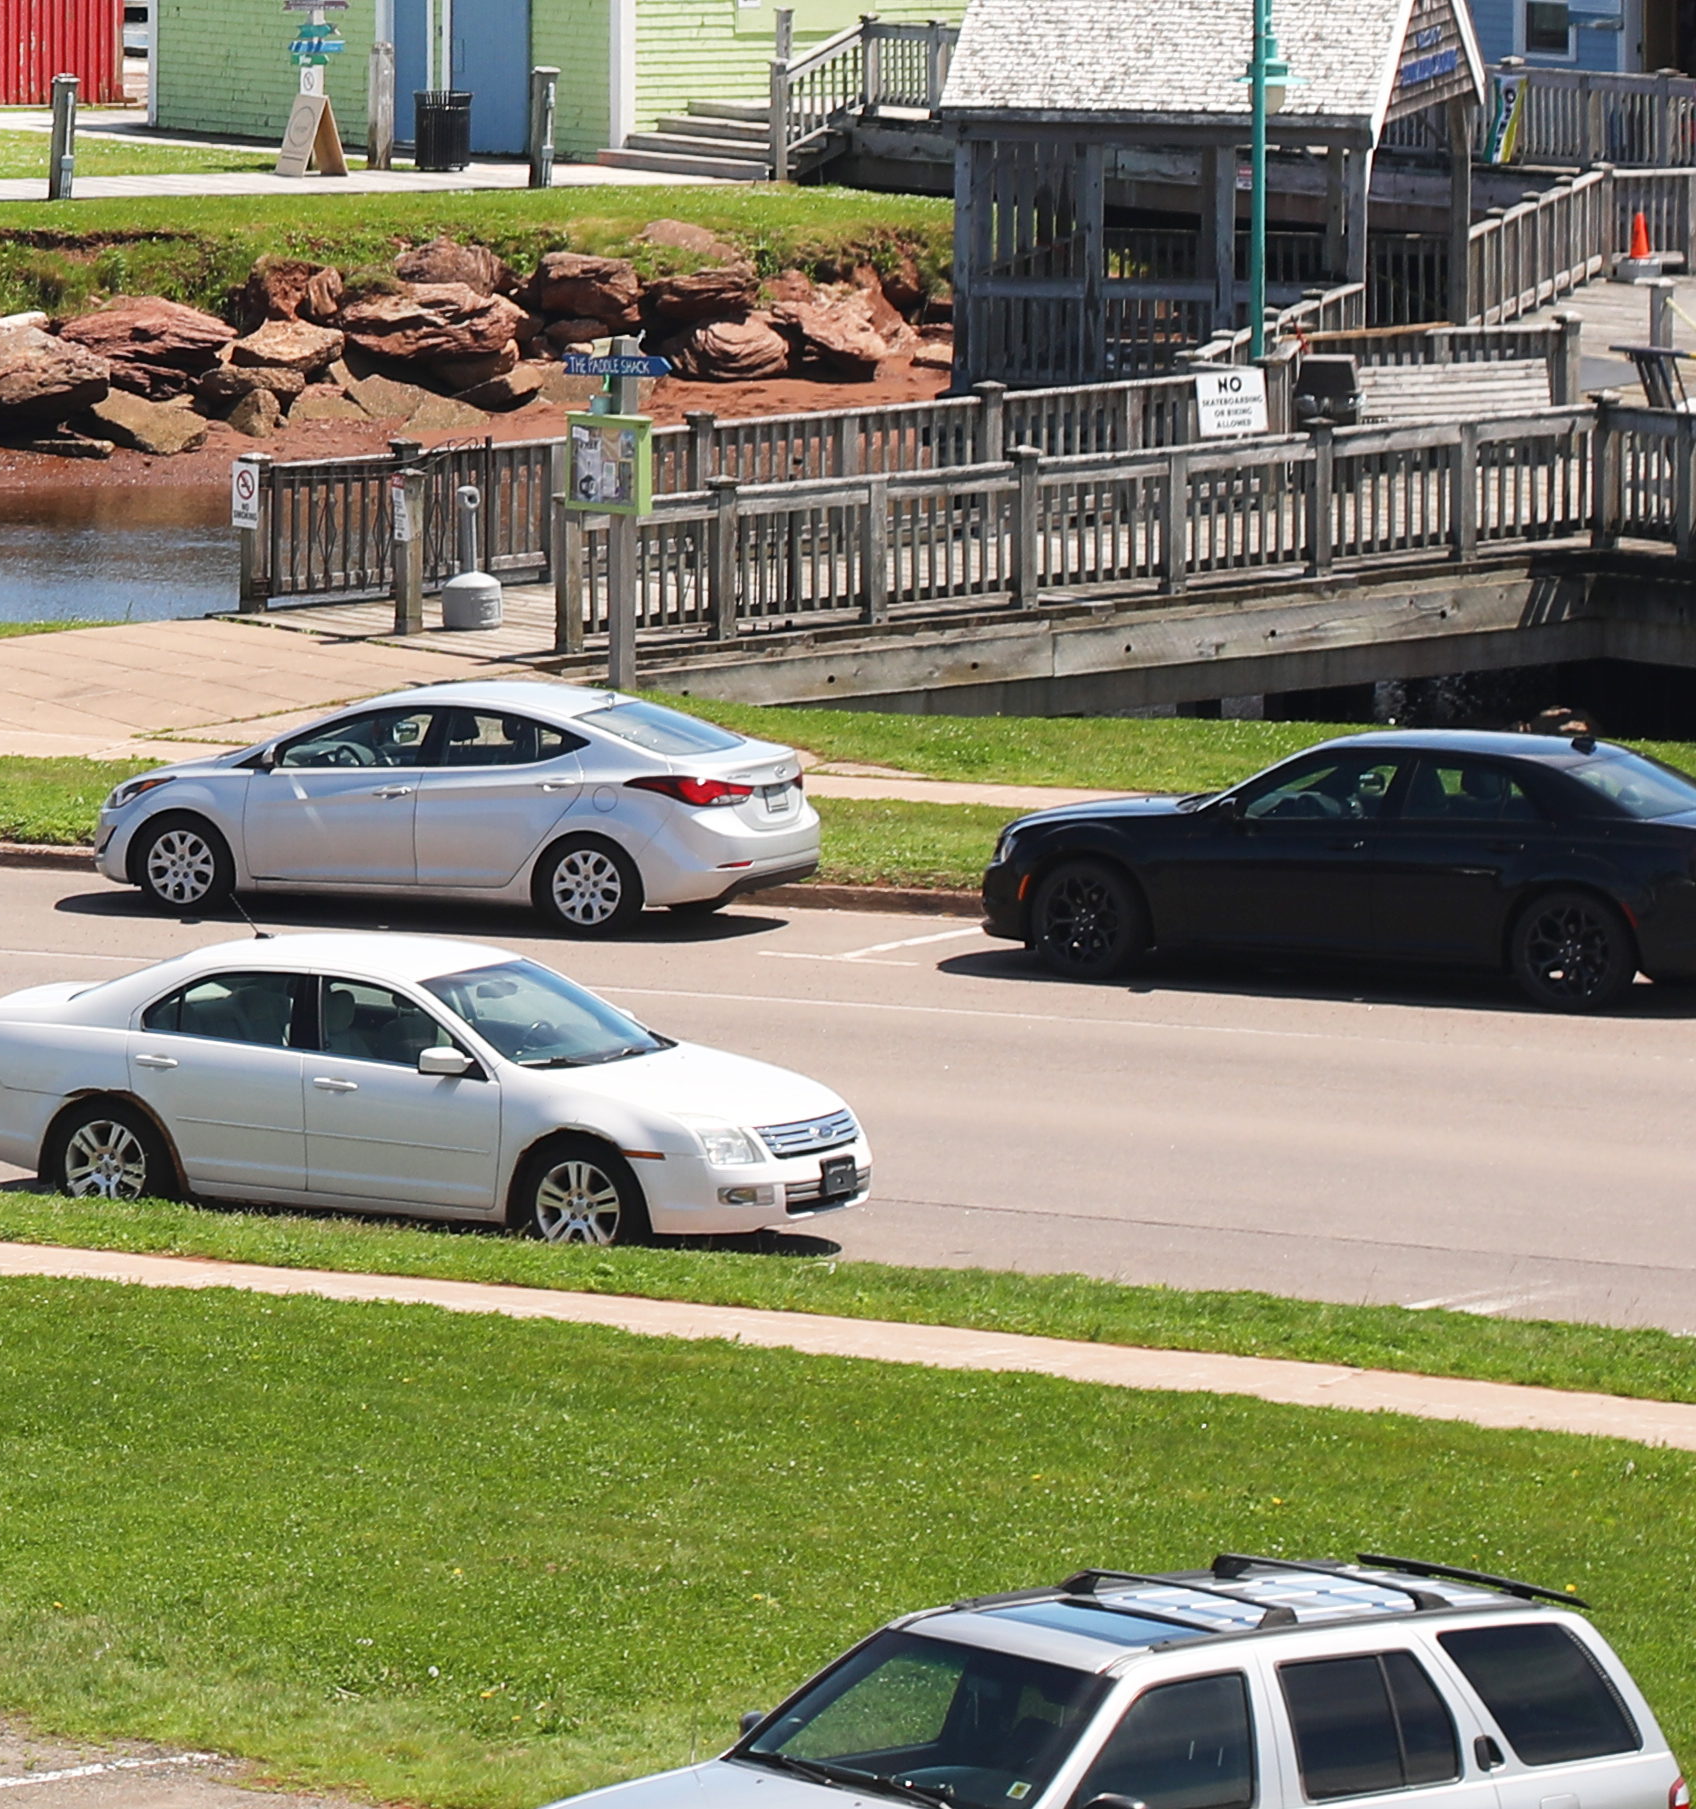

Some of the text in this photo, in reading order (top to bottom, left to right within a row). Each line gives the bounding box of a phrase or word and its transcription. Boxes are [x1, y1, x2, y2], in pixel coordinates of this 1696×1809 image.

[569, 356, 650, 374] THE PADDLE SHACK
[1217, 376, 1242, 393] NO
[1202, 394, 1263, 407] SKATEBOARDING
[1214, 406, 1253, 418] OR BIKING
[1216, 418, 1252, 429] ALLOWED
